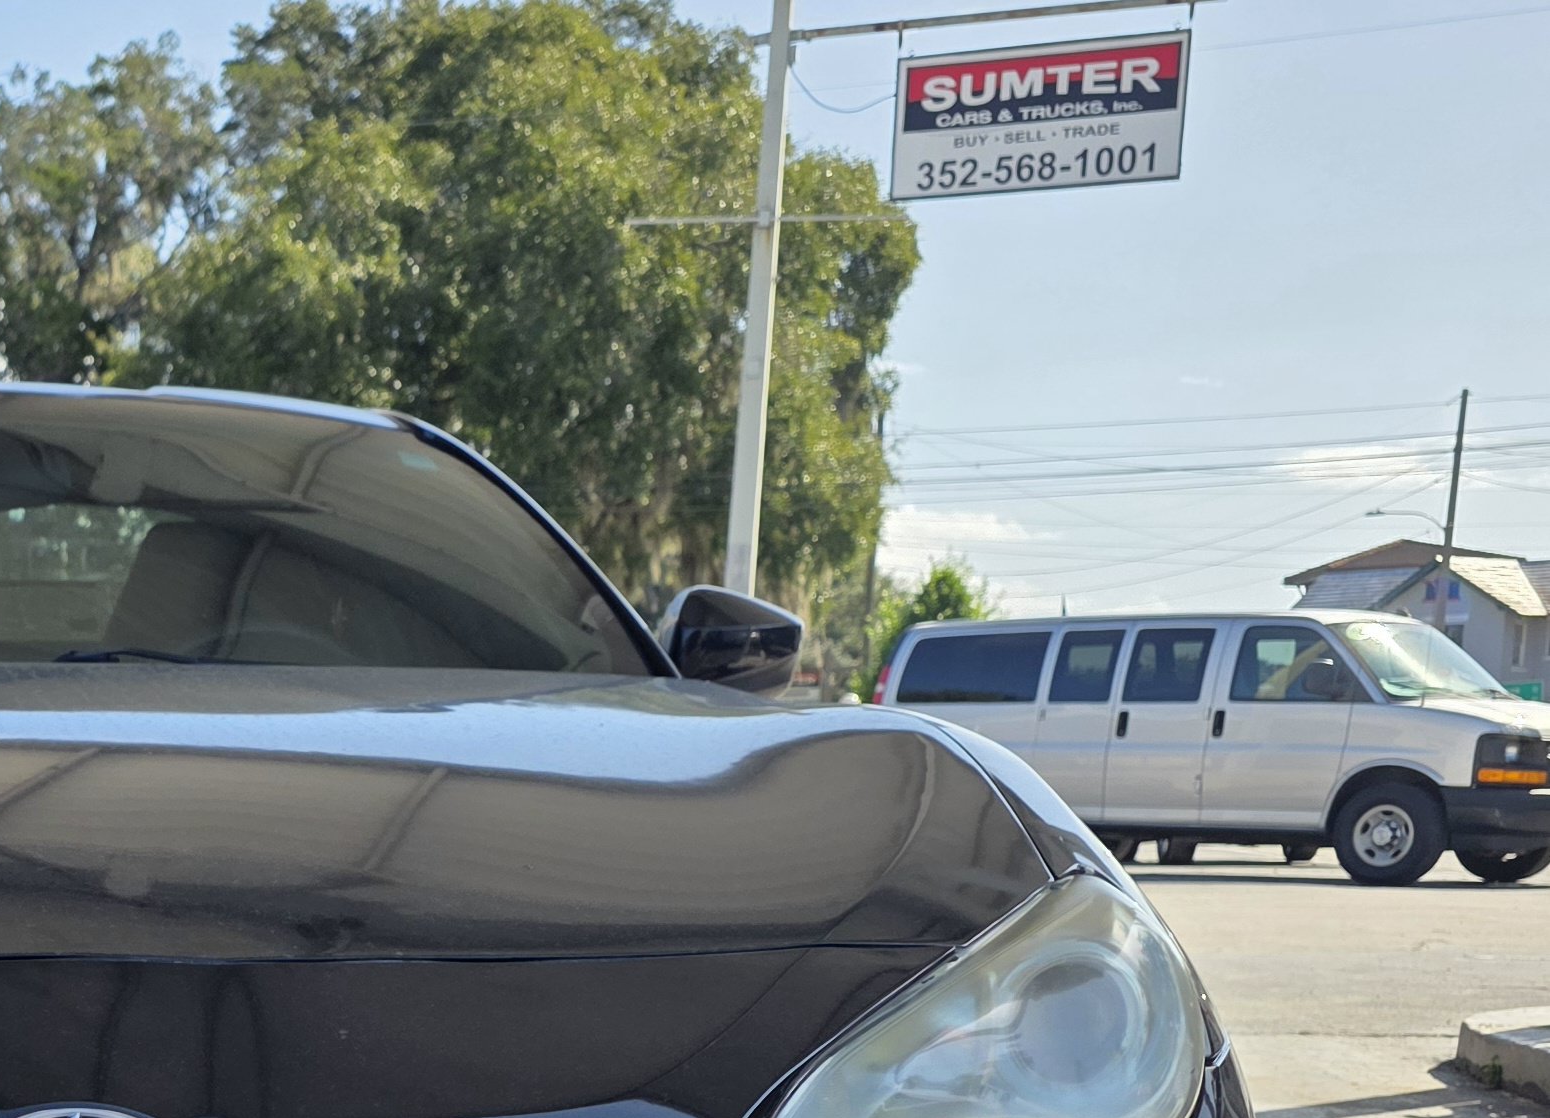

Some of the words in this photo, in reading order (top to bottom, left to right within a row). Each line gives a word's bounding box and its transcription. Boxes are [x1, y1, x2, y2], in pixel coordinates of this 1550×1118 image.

[920, 56, 1162, 113] SUMTER
[935, 108, 993, 128] CARS
[997, 107, 1014, 122] &
[953, 134, 989, 149] BUY
[1003, 129, 1047, 145] SELL
[1063, 122, 1121, 139] TRADE
[917, 142, 1157, 191] 352-568-1001
